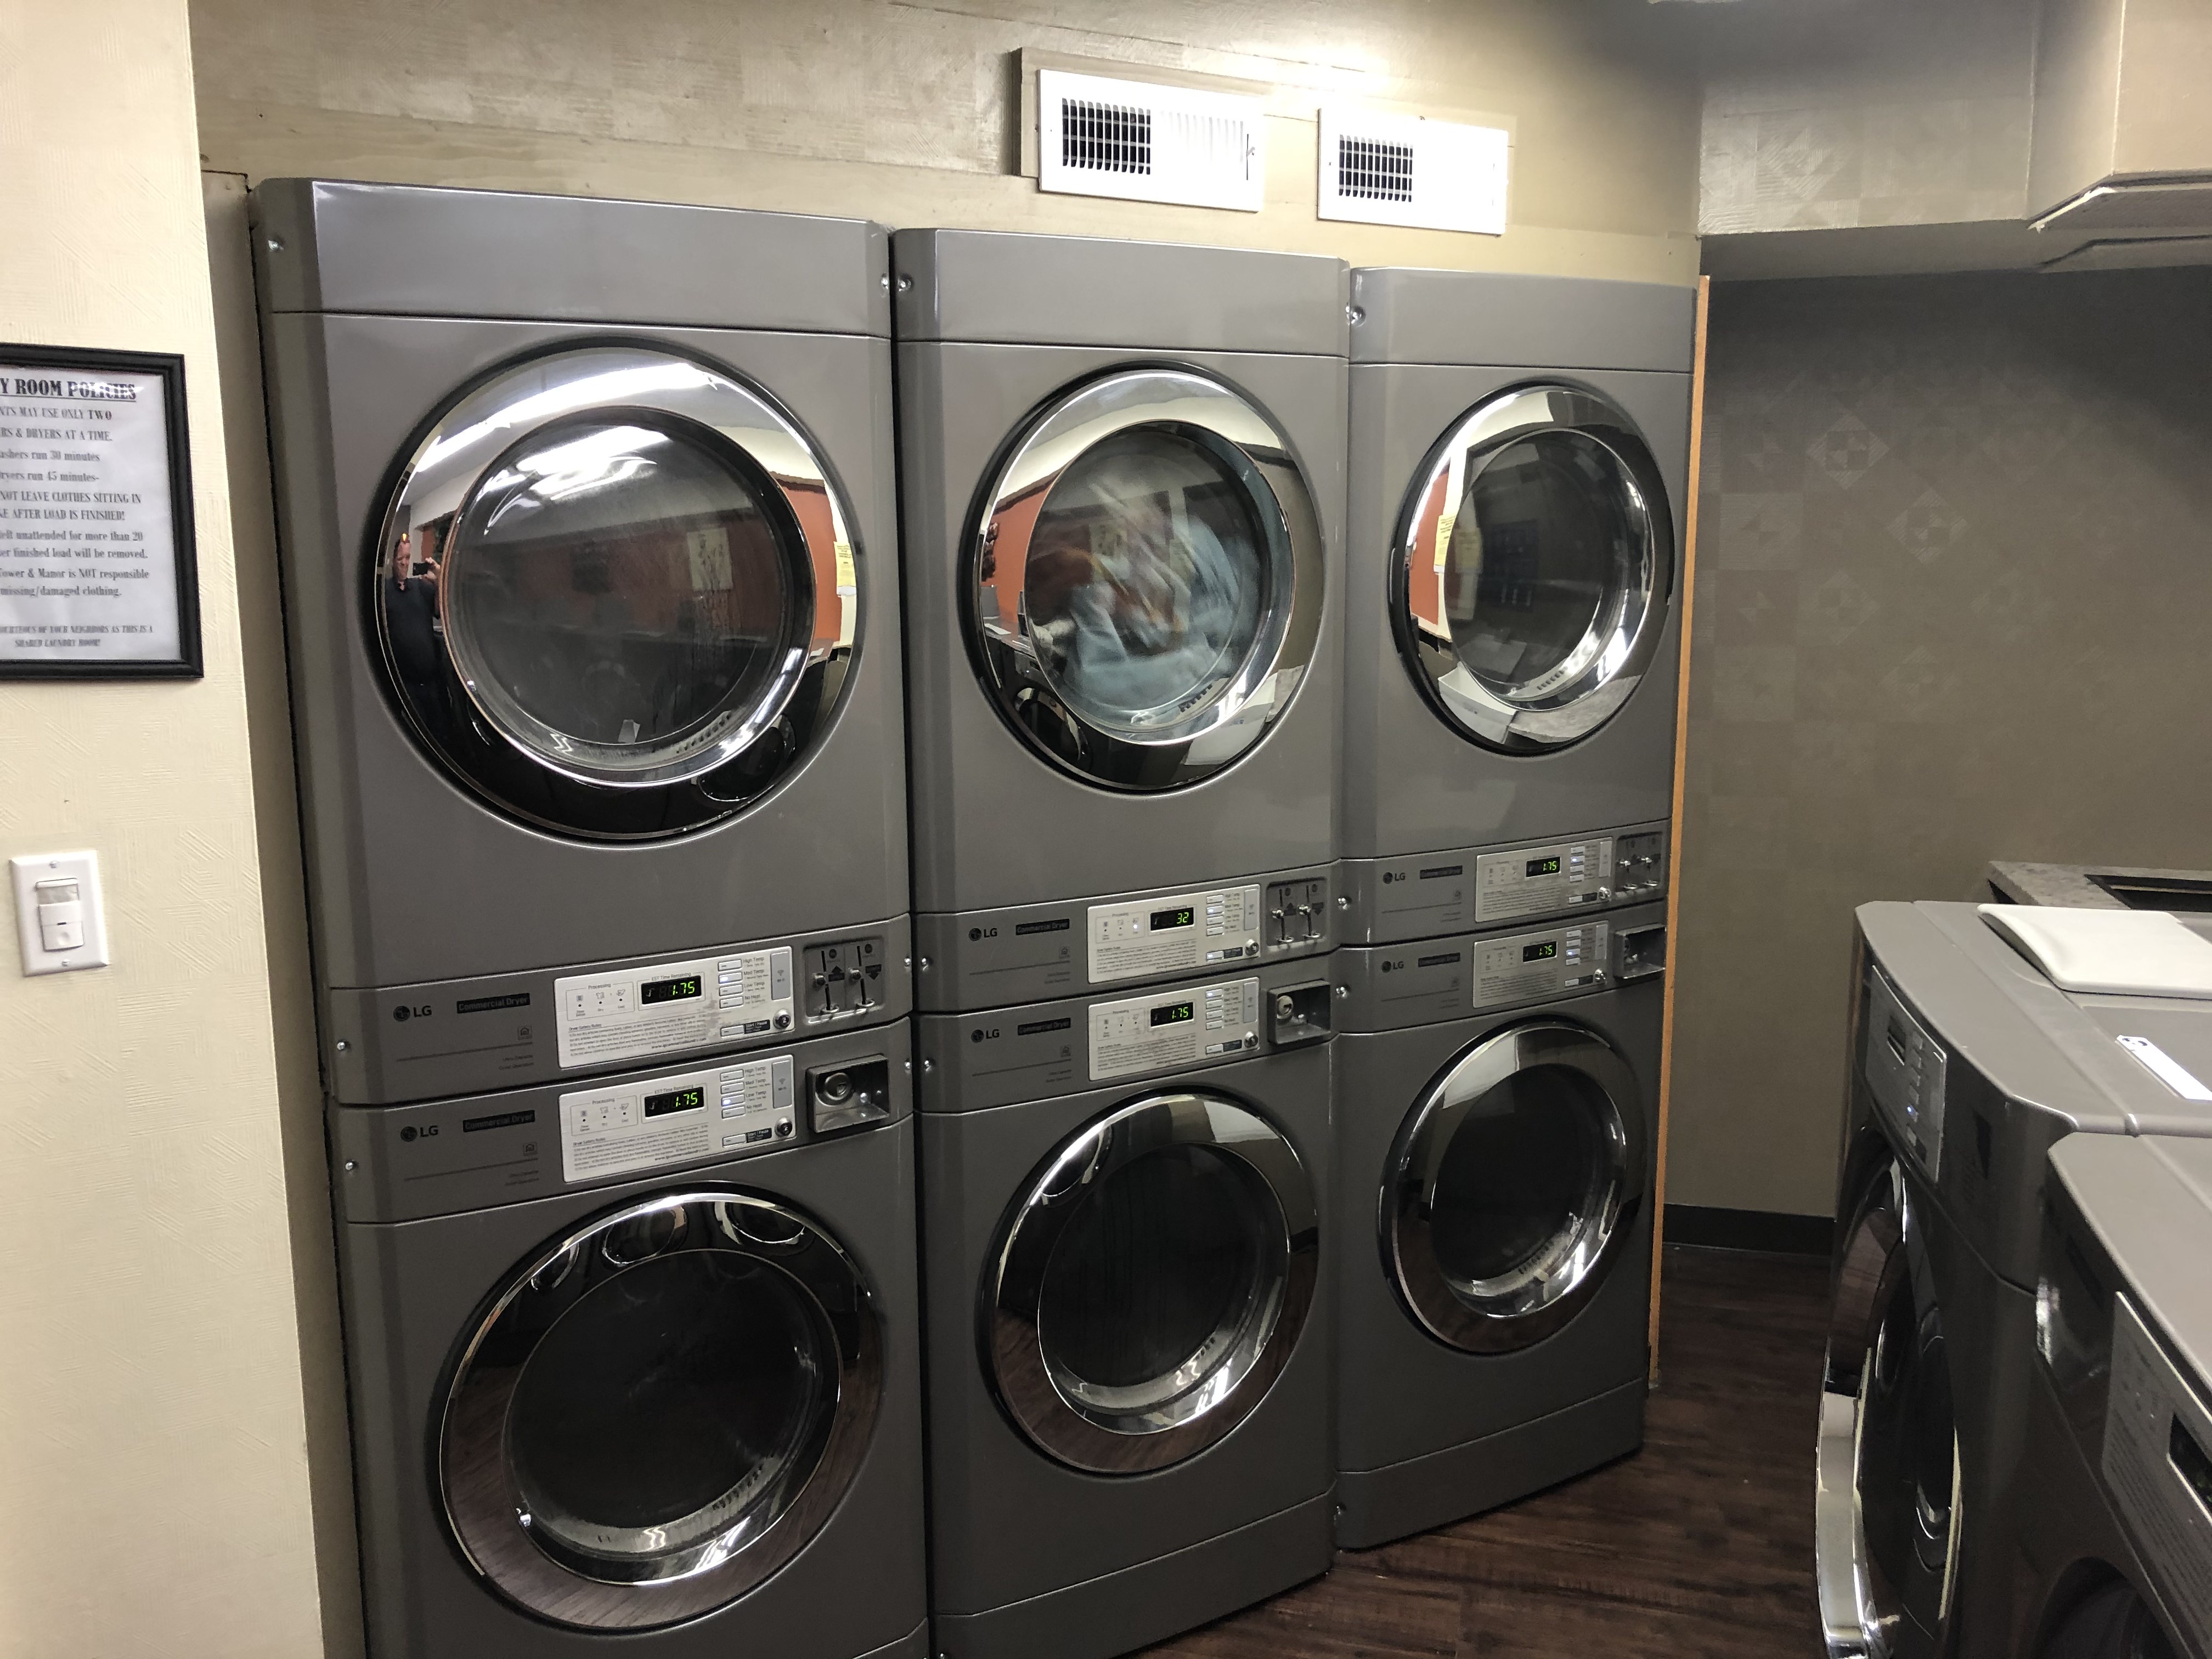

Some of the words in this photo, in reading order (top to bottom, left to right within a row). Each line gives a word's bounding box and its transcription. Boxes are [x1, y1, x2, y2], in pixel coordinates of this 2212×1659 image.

[14, 379, 63, 395] ROOM
[67, 380, 137, 400] POLICIES
[20, 407, 38, 417] MAY
[42, 408, 59, 417] USE
[61, 409, 84, 419] ONLY
[89, 410, 112, 420] TWO
[15, 428, 22, 438] &
[26, 428, 61, 439] DRYERS
[65, 430, 76, 439] AT
[80, 430, 86, 440] A
[89, 431, 112, 442] TIME.
[50, 450, 61, 460] 30
[64, 451, 100, 461] minutes
[27, 473, 44, 481] run
[48, 471, 57, 481] 45
[21, 491, 49, 501] LEAVE
[52, 492, 91, 503] CLOTHES
[93, 492, 129, 504] SITTING
[132, 493, 142, 504] IN
[13, 509, 41, 519] AFTER
[44, 509, 66, 520] LOAD
[70, 510, 78, 520] IS
[81, 510, 126, 521] FINISHED!
[16, 530, 66, 540] unattended
[69, 530, 82, 540] for
[85, 532, 108, 541] more
[110, 531, 130, 541] than
[132, 531, 144, 541] 20
[13, 548, 50, 557] finished
[53, 548, 72, 557] load
[75, 548, 91, 558] will
[94, 548, 104, 558] be
[108, 548, 149, 558] removed.
[27, 568, 35, 578] &
[38, 568, 65, 578] Manor
[69, 568, 76, 578] is
[78, 568, 97, 579] NOT
[100, 568, 150, 581] responsible
[82, 585, 122, 598] clothing.
[121, 625, 138, 634] THIS
[139, 625, 146, 633] IS
[1395, 872, 1406, 881] LG
[1176, 912, 1189, 924] 32
[984, 927, 997, 938] LG
[1017, 923, 1051, 933] Commercial
[1052, 922, 1068, 930] Dryer
[1392, 961, 1404, 970] LG
[672, 981, 695, 996] 1.75
[413, 1005, 433, 1018] LG
[458, 997, 505, 1012] Commercial
[506, 996, 528, 1006] Dryer
[1172, 1007, 1189, 1019] 1.75
[986, 1029, 1000, 1039] LG
[1053, 1020, 1069, 1029] Dryer
[675, 1092, 698, 1107] 1.75
[419, 1125, 439, 1138] LG
[465, 1116, 511, 1130] Commercial
[511, 1112, 533, 1124] Dryer
